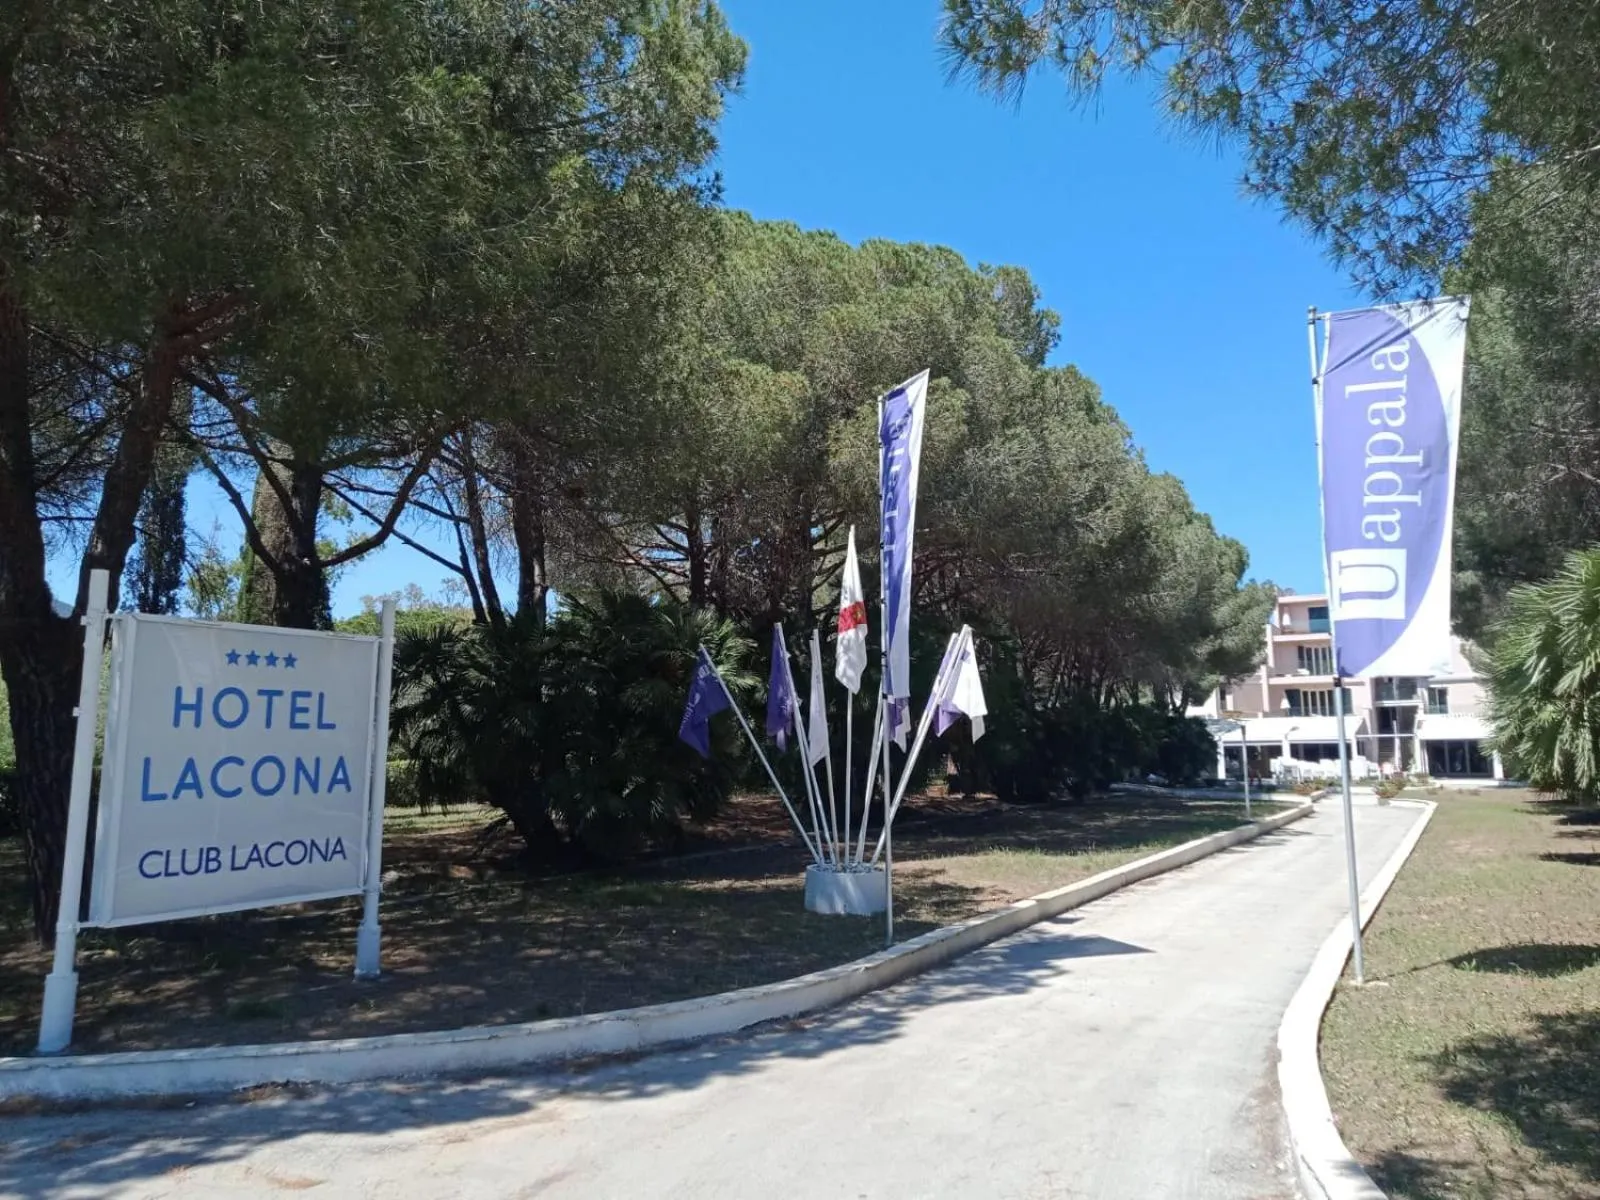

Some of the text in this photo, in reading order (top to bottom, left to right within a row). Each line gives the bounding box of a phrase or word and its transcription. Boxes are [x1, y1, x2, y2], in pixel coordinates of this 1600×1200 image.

[1338, 339, 1424, 608] Uappala
[172, 686, 336, 730] HOTEL
[141, 755, 352, 802] LACONA
[138, 837, 347, 879] CLUB LACONA
